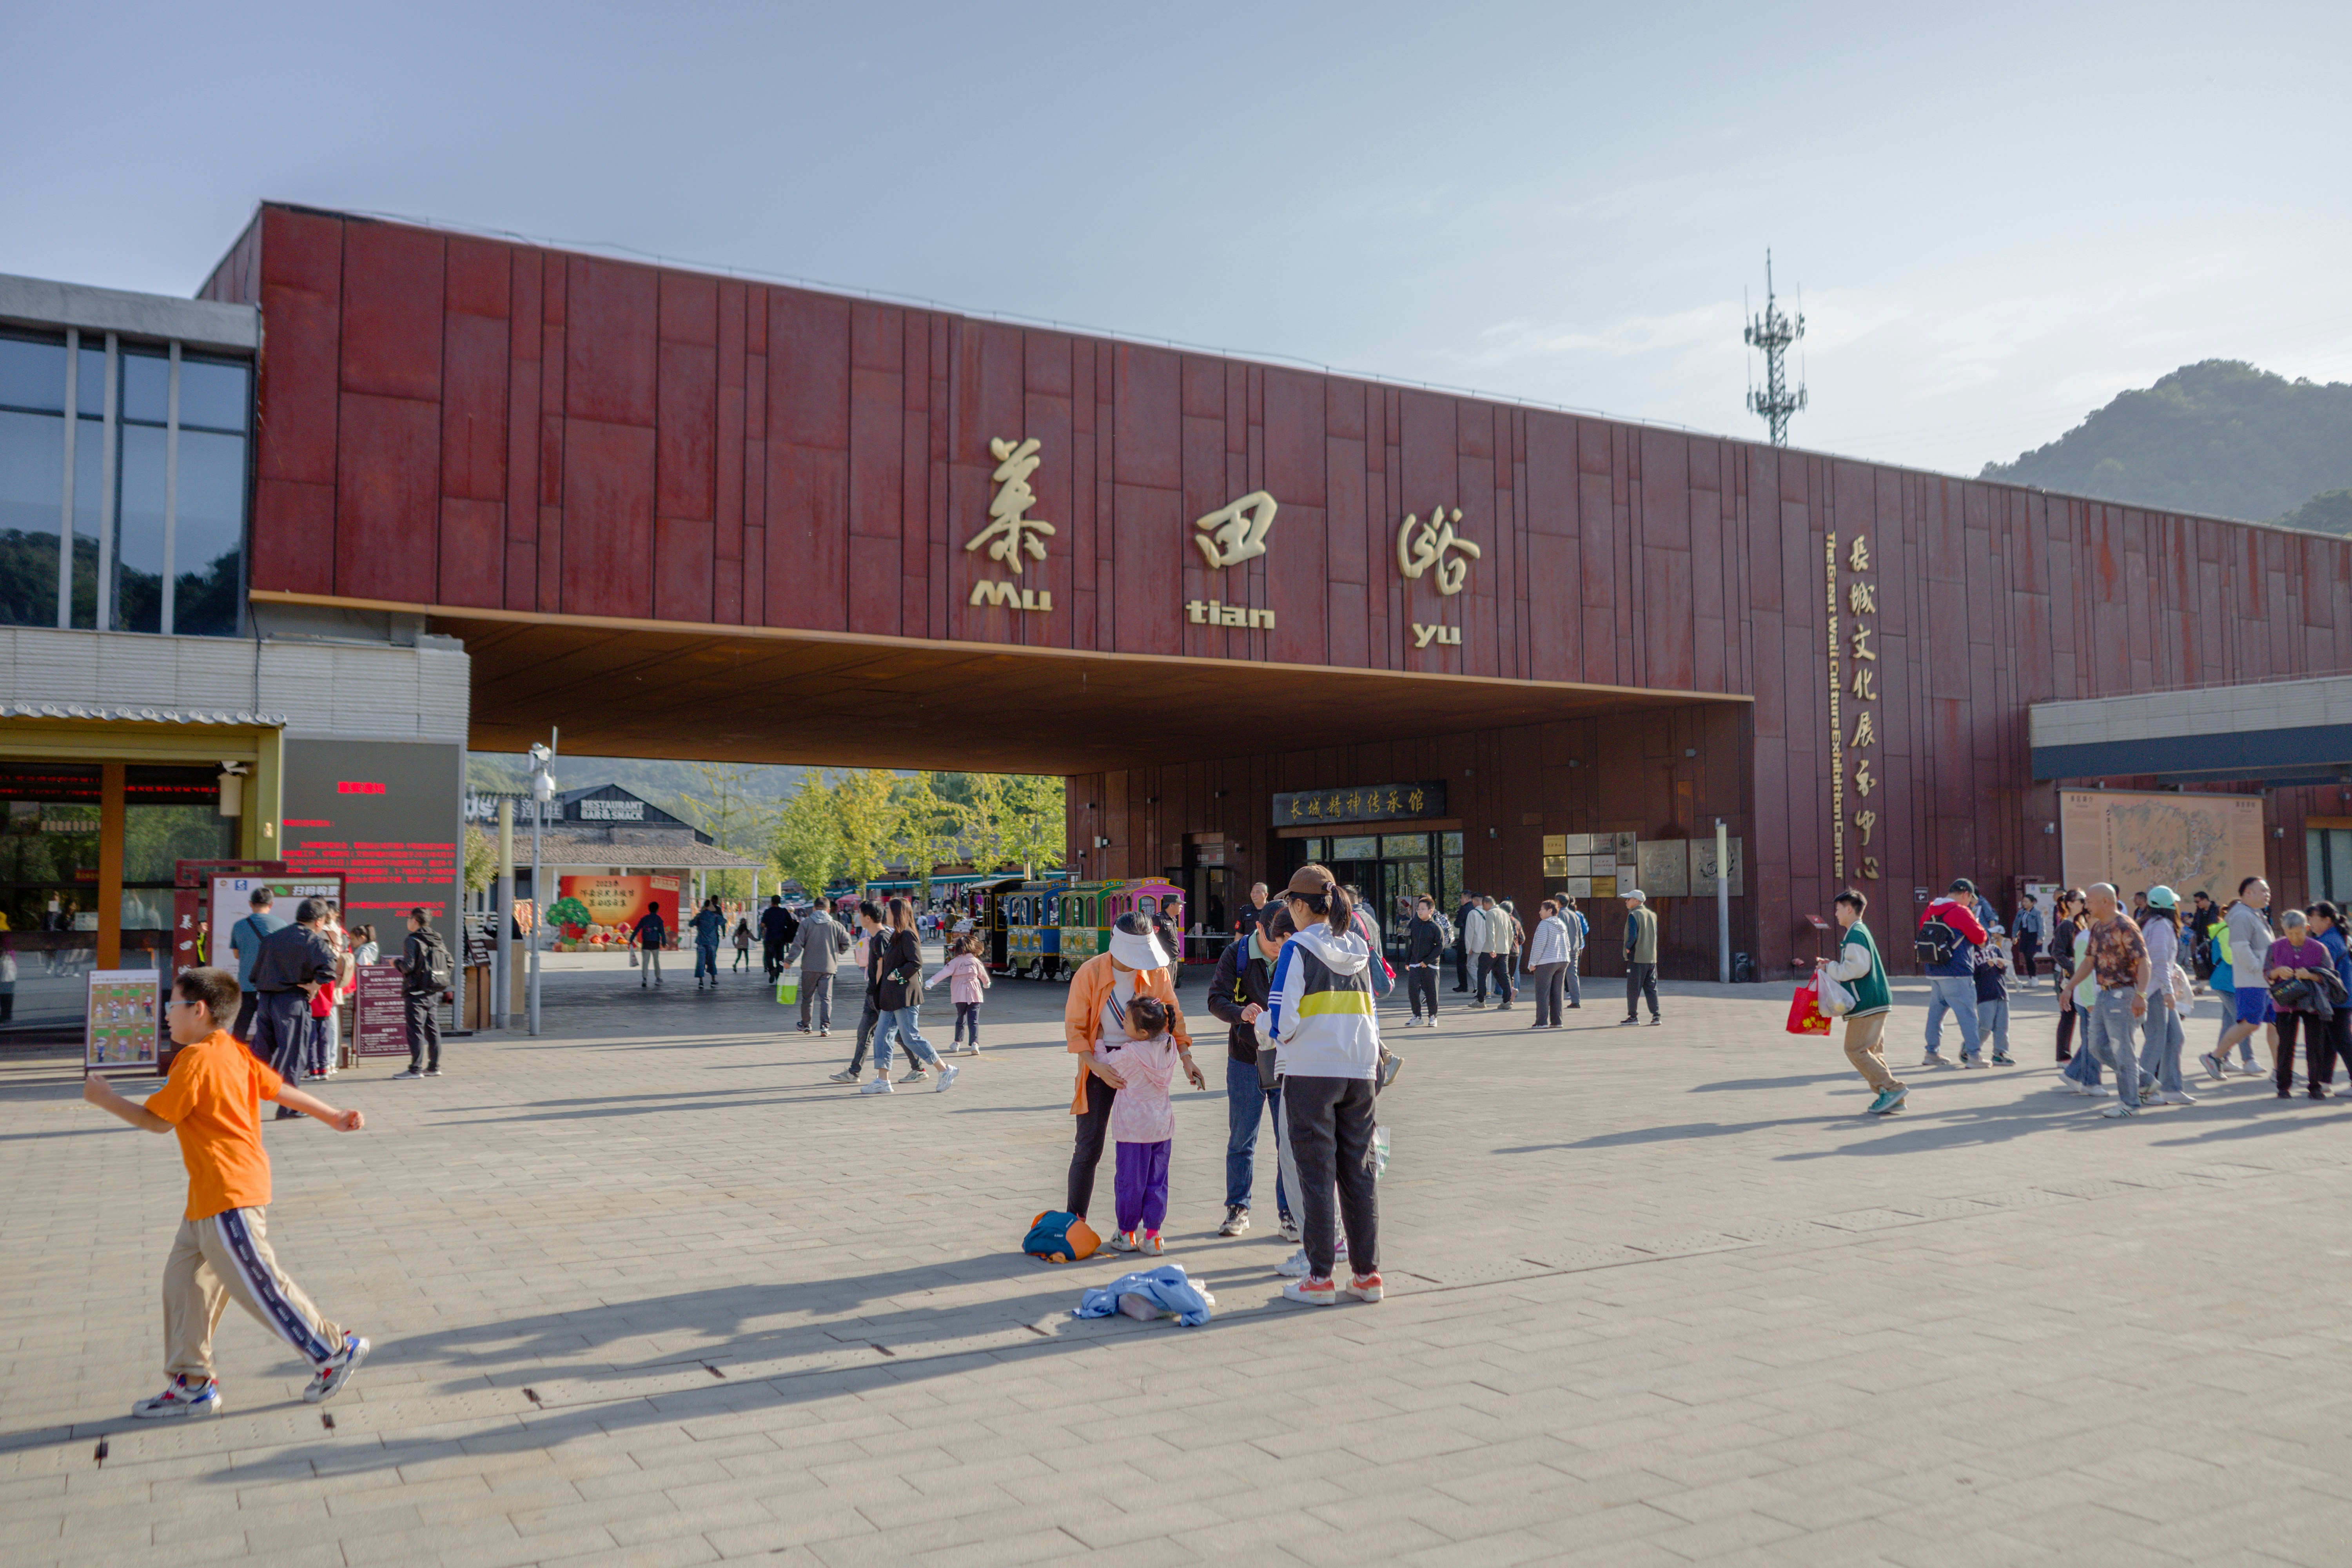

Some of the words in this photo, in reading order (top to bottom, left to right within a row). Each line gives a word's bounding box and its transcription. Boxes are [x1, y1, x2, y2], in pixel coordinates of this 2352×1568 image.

[1826, 530, 1837, 564] The
[1827, 564, 1838, 614] Great
[970, 580, 1053, 612] Mu
[1186, 599, 1275, 629] tian
[1413, 623, 1462, 648] yu
[1828, 615, 1840, 659] Wall
[1831, 730, 1843, 820] Exhibition
[581, 799, 644, 810] RESTAURANT
[581, 810, 644, 821] BAR&SNACK
[1290, 788, 1424, 820] 长城精神传承馆
[1834, 821, 1844, 880] Center
[292, 885, 340, 897] 扫码购票
